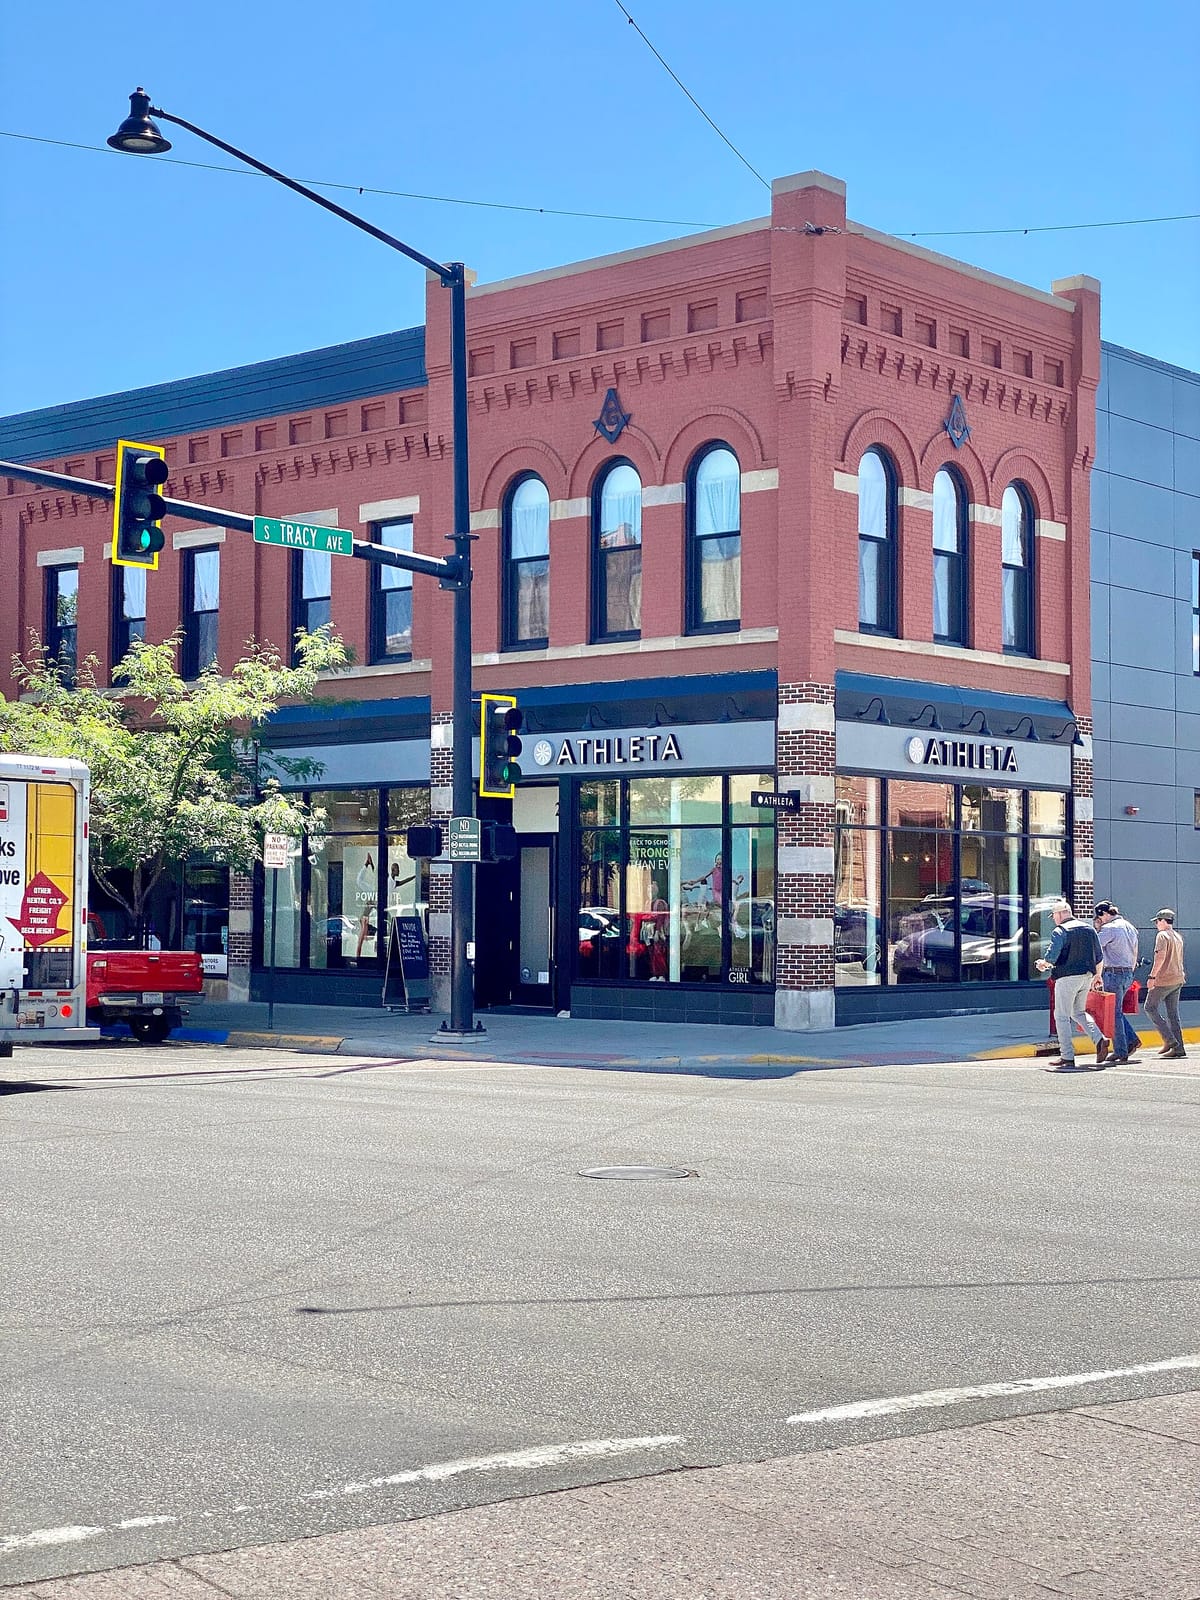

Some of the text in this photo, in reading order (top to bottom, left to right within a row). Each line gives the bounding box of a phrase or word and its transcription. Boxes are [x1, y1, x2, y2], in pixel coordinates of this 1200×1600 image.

[263, 523, 343, 551] S TRACY AVE
[556, 734, 681, 765] ATHLETA
[924, 738, 1019, 772] ATHLETA
[763, 796, 794, 807] ATHLETA
[459, 819, 470, 832] NO
